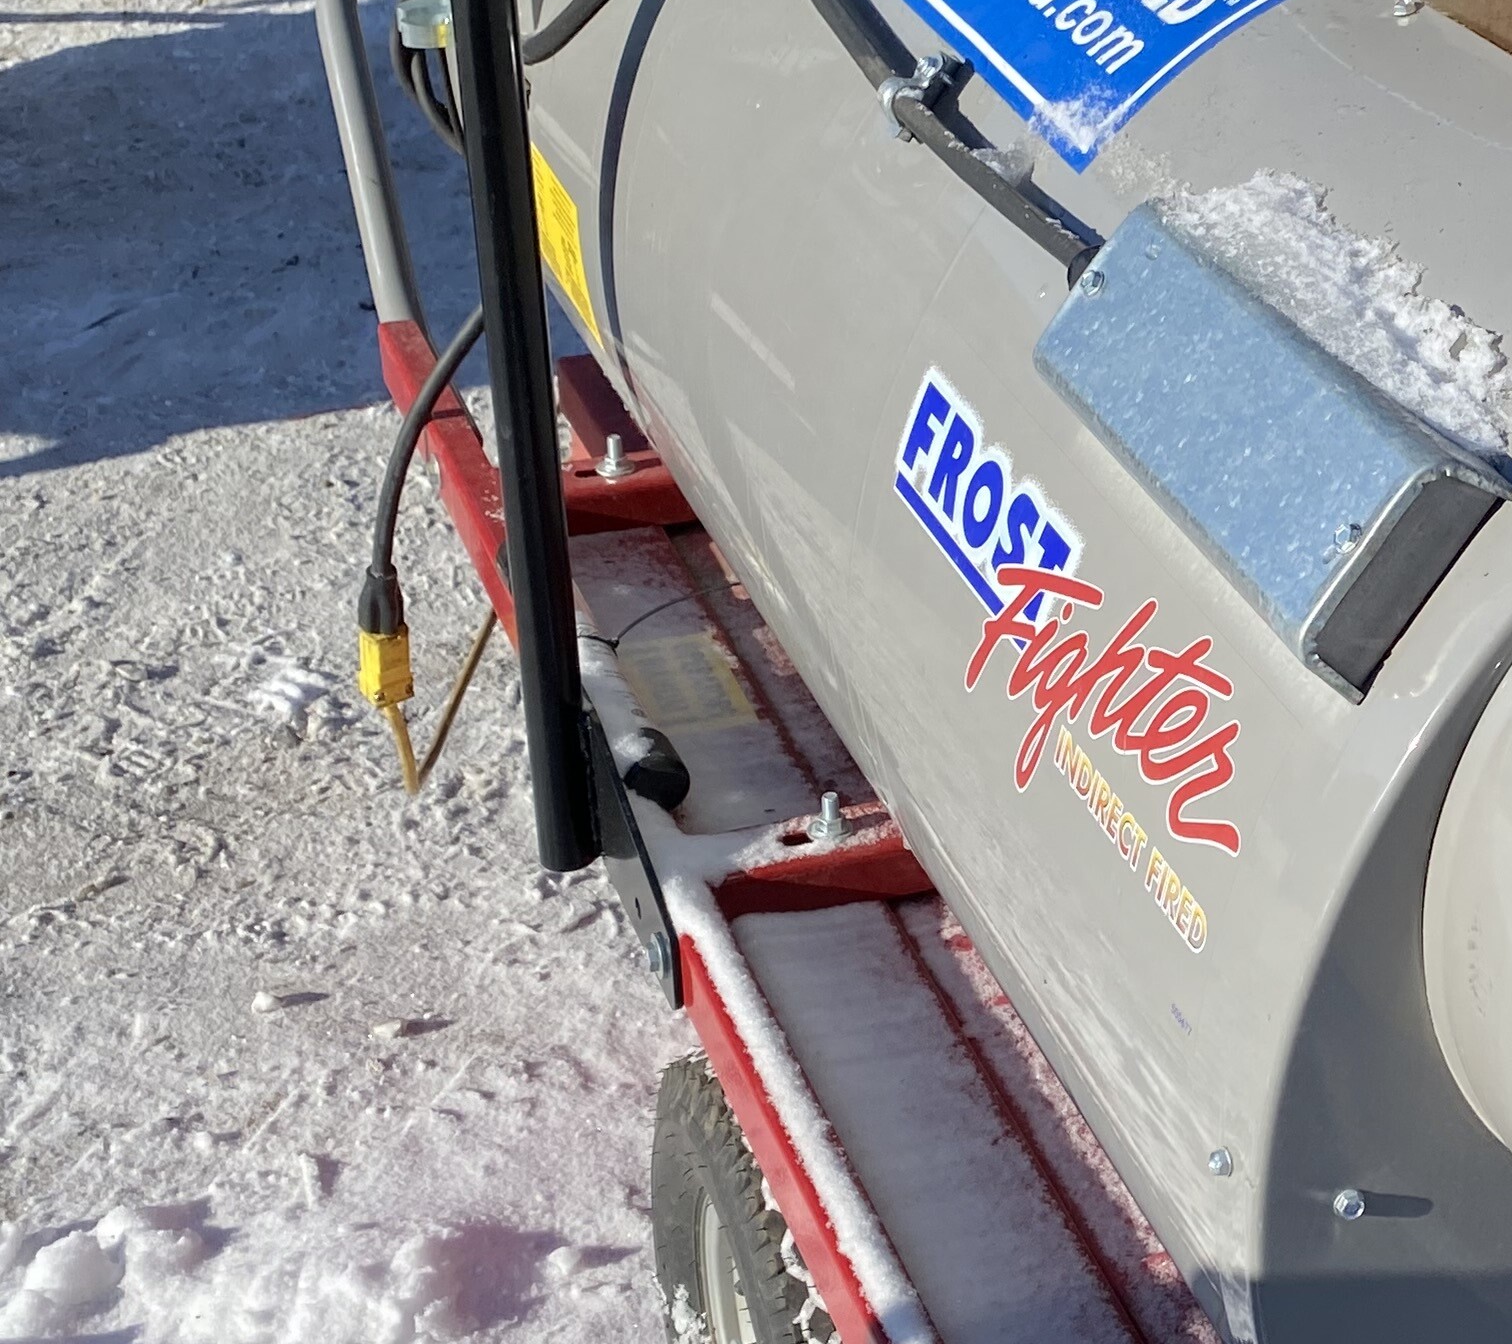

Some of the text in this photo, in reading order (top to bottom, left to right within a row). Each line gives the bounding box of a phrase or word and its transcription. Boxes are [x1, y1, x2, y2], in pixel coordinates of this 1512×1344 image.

[902, 381, 1073, 622] FROST
[965, 564, 1240, 857] Fighter
[1053, 724, 1208, 953] INDIRECT FIRED
